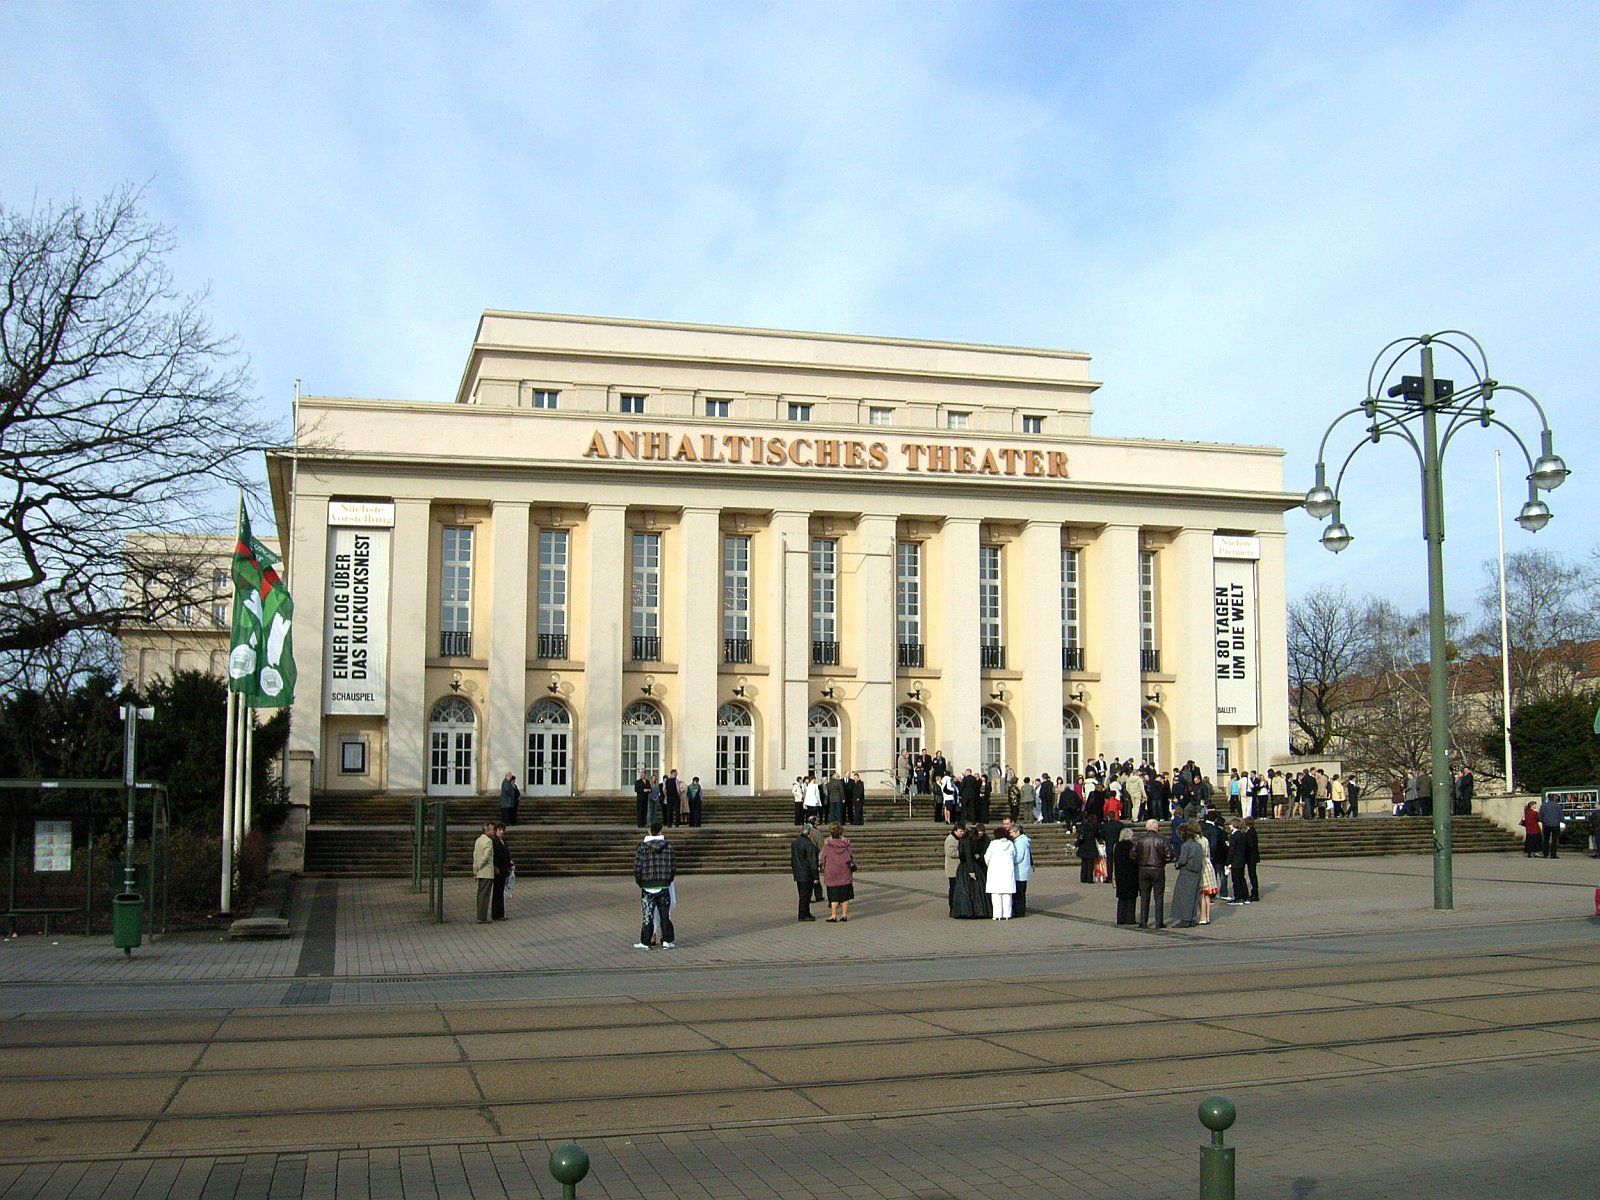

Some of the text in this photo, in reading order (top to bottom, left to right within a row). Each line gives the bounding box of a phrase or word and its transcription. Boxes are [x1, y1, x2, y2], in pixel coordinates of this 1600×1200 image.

[582, 429, 1070, 479] ANHALTISCHES THEATER
[331, 554, 351, 679] EINER FLOG ÜBER
[351, 534, 370, 680] DAS KUCKUCKSNEST
[1215, 587, 1230, 679] IN 80 TAGEN
[1231, 582, 1246, 680] UM DIE WELT
[331, 691, 375, 702] SCHAUSPIEL
